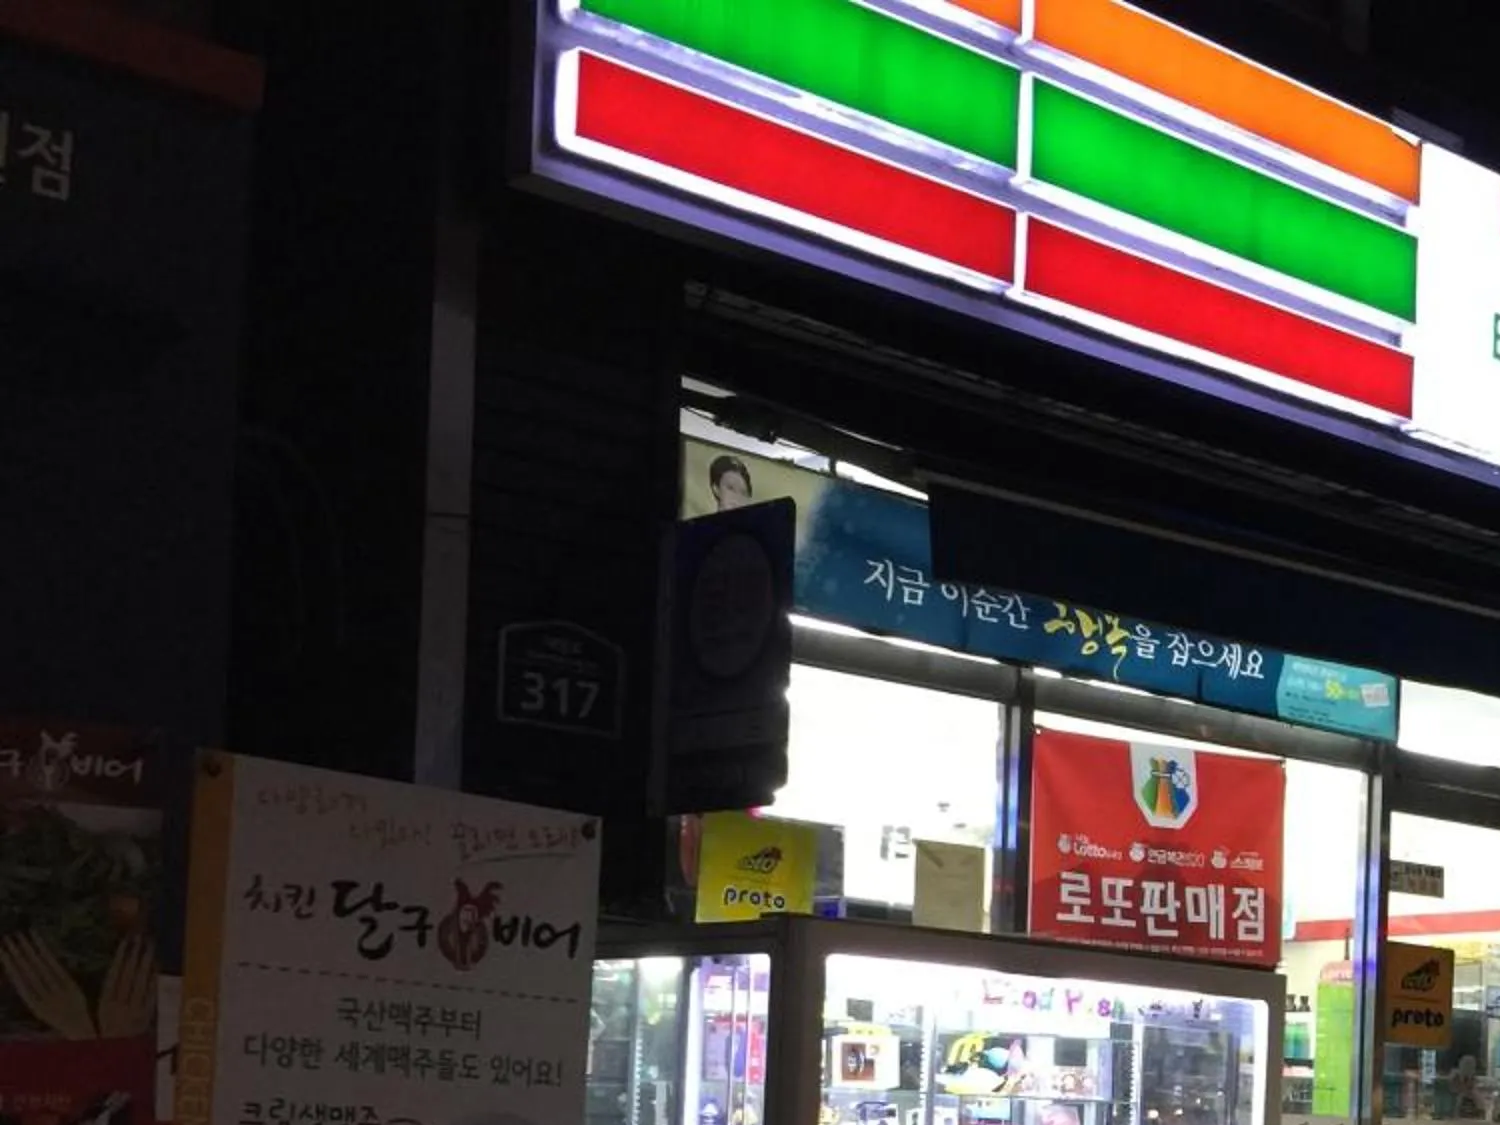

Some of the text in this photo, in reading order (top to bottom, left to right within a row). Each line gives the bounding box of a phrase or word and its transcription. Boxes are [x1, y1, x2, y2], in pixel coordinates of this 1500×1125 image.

[0, 108, 74, 202] 점
[864, 558, 930, 606] 지금
[1165, 631, 1265, 681] 잡으세요
[520, 670, 600, 719] 317
[243, 874, 316, 920] 치킨
[724, 886, 785, 909] proto
[1056, 871, 1265, 942] 로또판매점
[337, 997, 483, 1038] 국산맥주부터
[1391, 1007, 1445, 1028] proto
[243, 1034, 563, 1088] 다양한 세계맥주들도 있어요!
